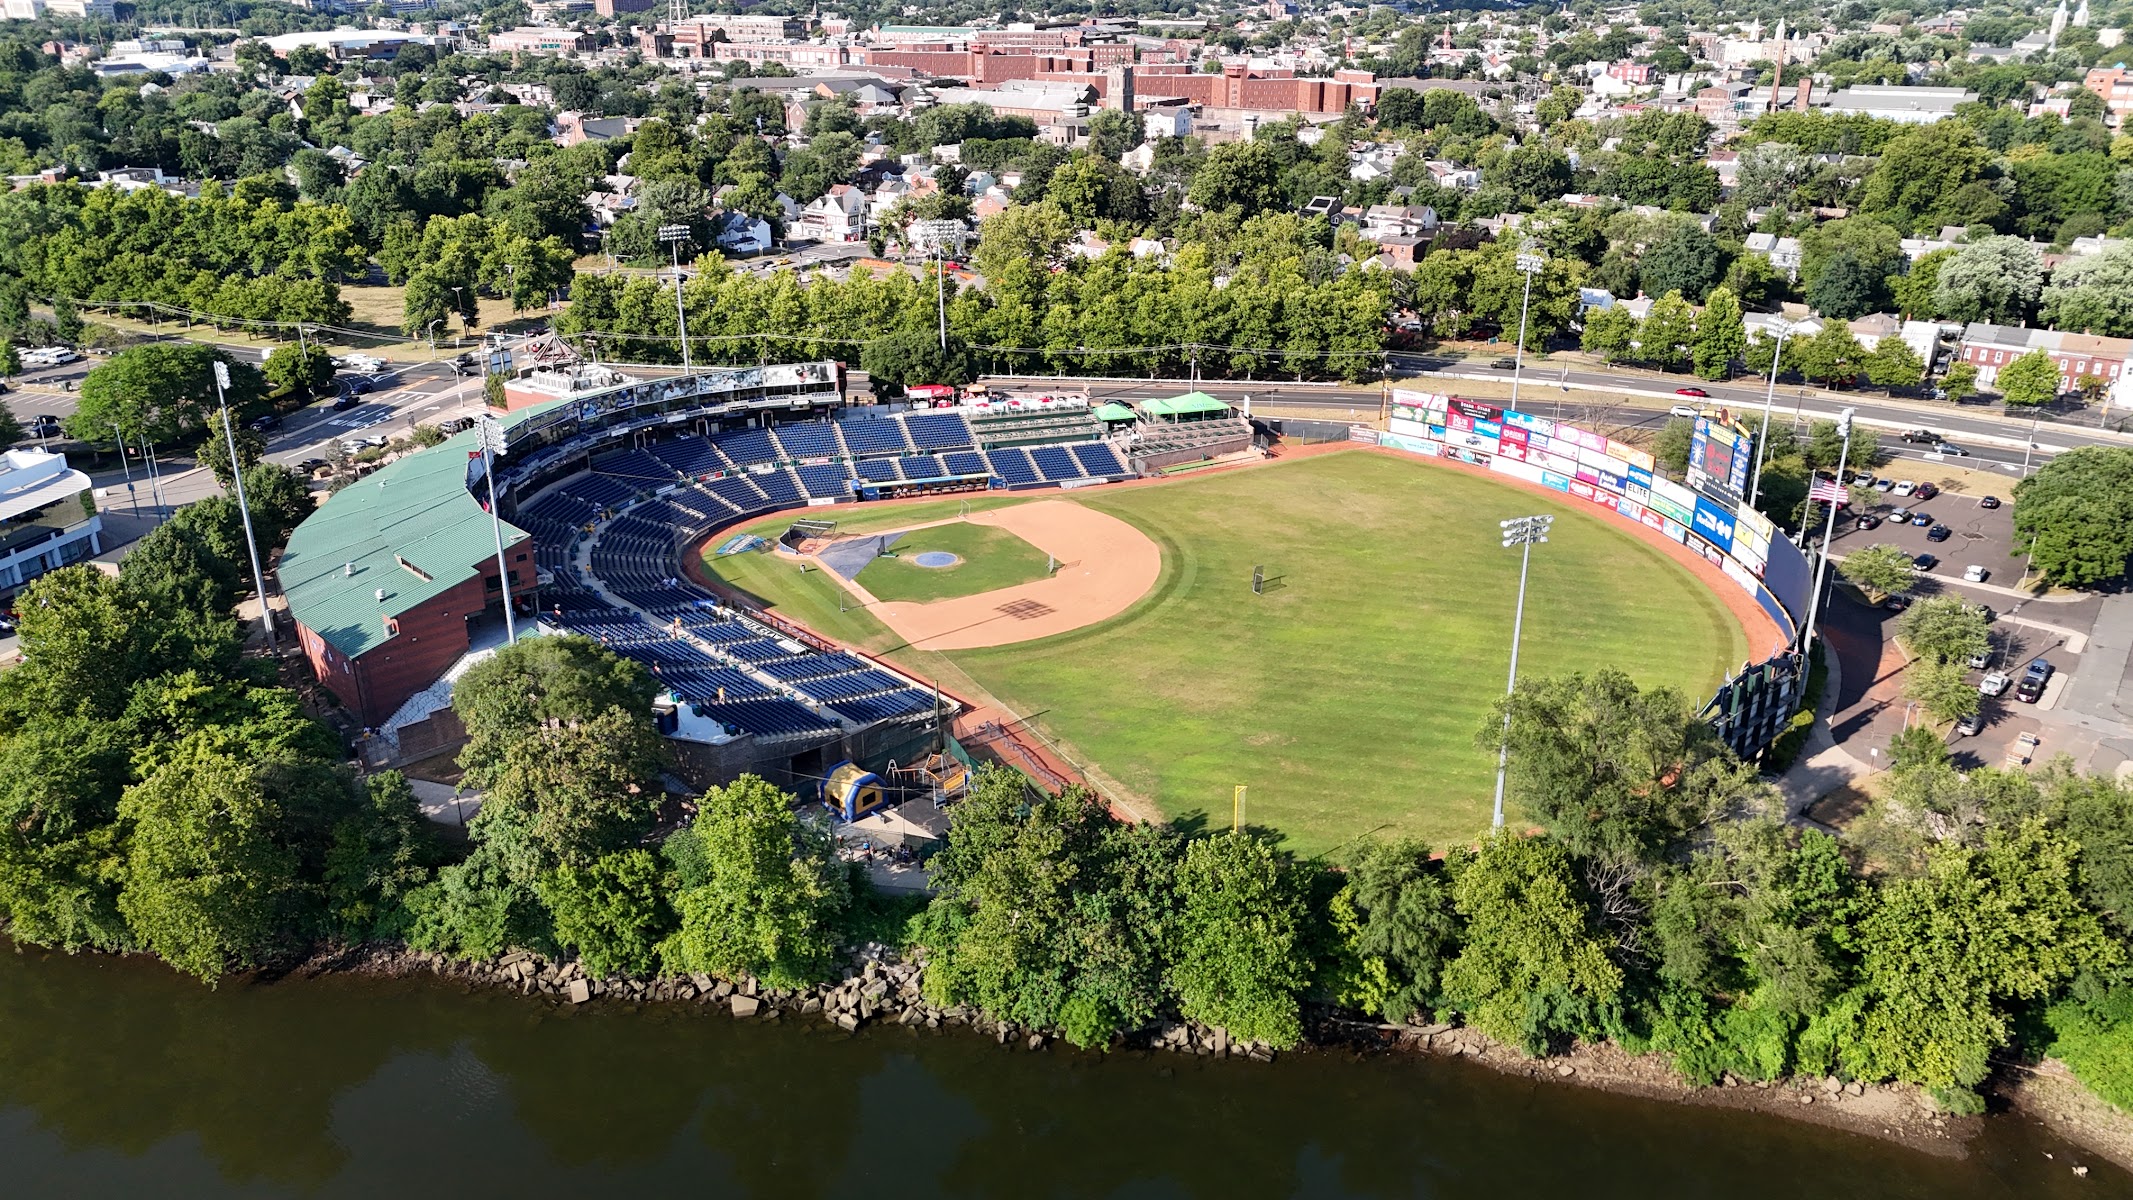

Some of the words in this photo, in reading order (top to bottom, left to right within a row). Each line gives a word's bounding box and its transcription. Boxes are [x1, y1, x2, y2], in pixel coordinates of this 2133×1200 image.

[1628, 483, 1648, 498] ELITE
[735, 615, 761, 632] WHITE
[759, 628, 785, 640] CLAW
